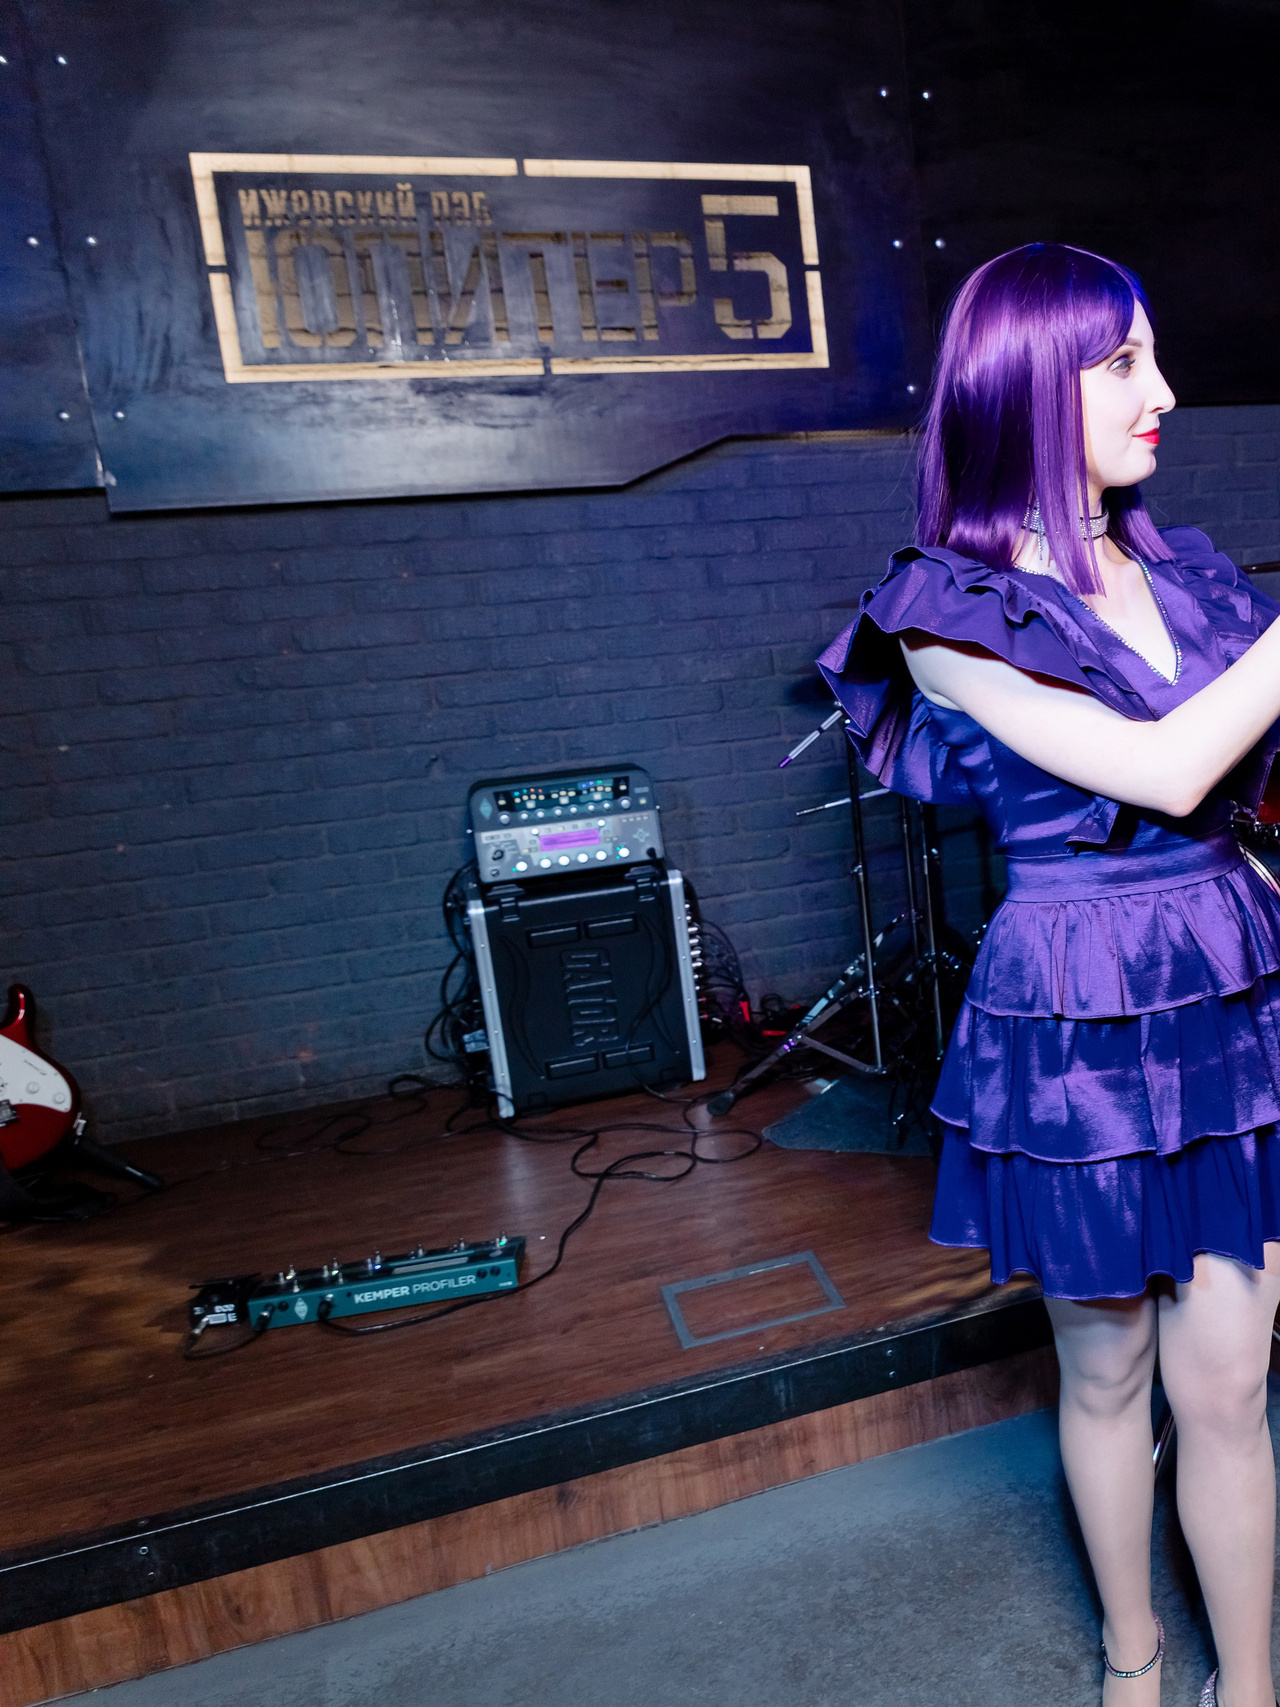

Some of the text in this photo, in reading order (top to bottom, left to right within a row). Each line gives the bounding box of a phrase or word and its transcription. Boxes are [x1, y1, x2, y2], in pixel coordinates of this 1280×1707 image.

[701, 194, 792, 339] 5
[353, 1273, 477, 1305] KEMPER PROFILER
